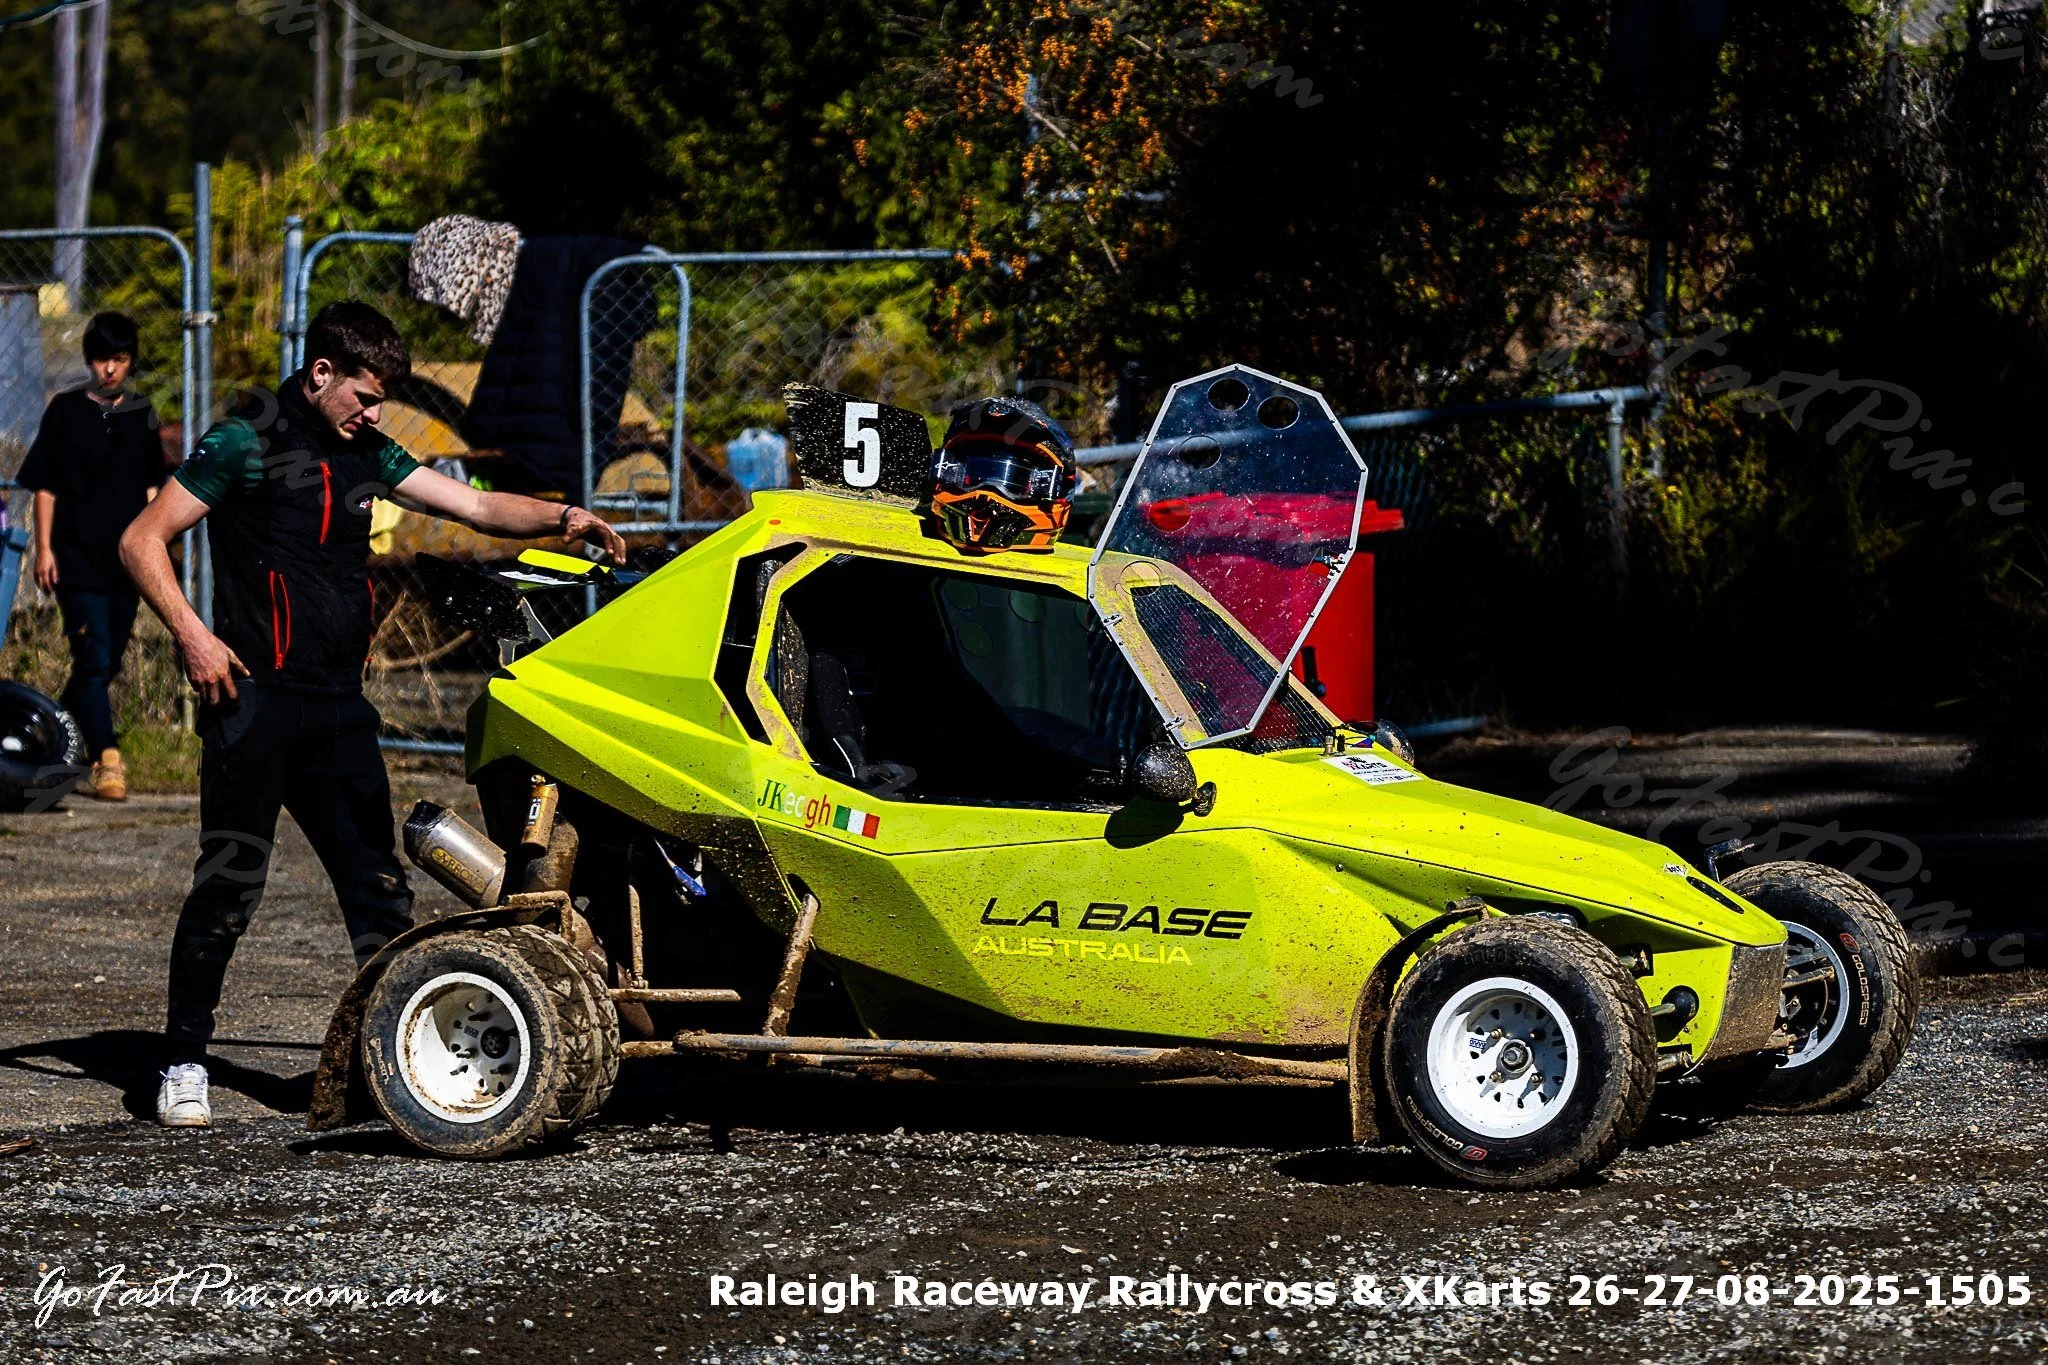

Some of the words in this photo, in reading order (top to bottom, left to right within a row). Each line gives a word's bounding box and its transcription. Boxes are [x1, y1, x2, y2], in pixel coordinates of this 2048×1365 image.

[842, 400, 881, 488] 5
[756, 779, 831, 829] JKeogh
[980, 897, 1060, 929] LA
[1077, 901, 1254, 940] BASE
[971, 935, 1193, 966] AUSTRALIA
[1851, 953, 1870, 1026] GOLDSPEED
[1405, 1095, 1464, 1151] GOLDSPEED
